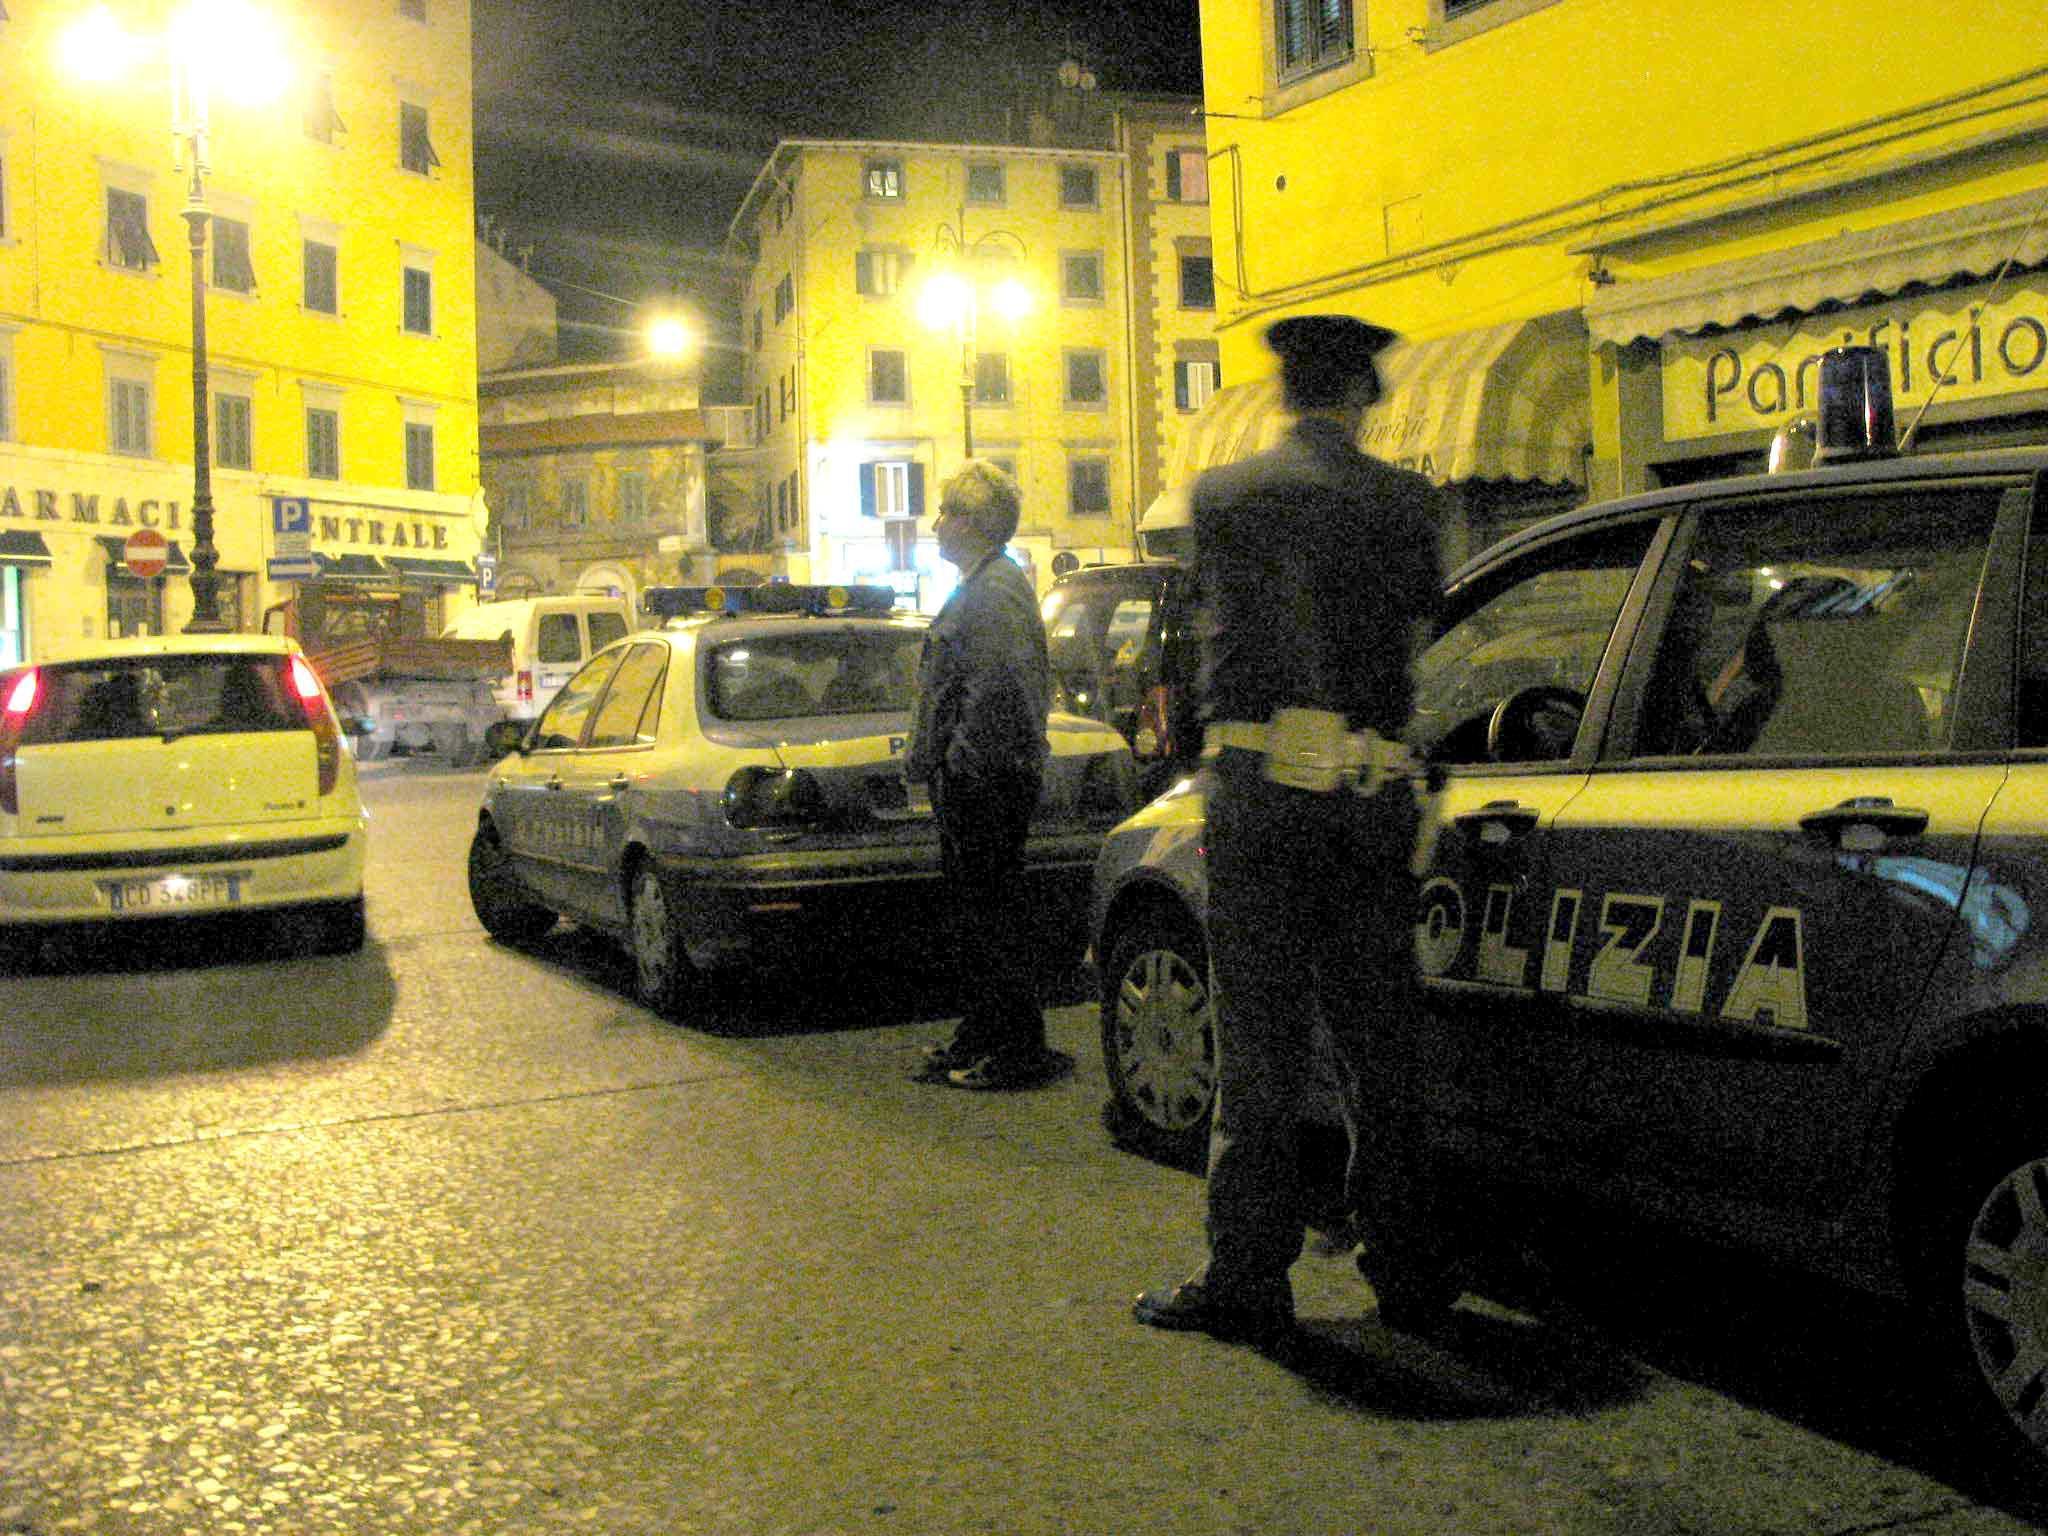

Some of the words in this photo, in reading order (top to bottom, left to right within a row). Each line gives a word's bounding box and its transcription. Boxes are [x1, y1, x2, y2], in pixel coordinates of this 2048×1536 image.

[1707, 308, 2047, 422] Panficio
[0, 486, 194, 530] ARMACI
[281, 501, 302, 530] P
[309, 515, 448, 549] NTRALE
[483, 567, 493, 588] P
[1415, 876, 1809, 1029] OLIZIA
